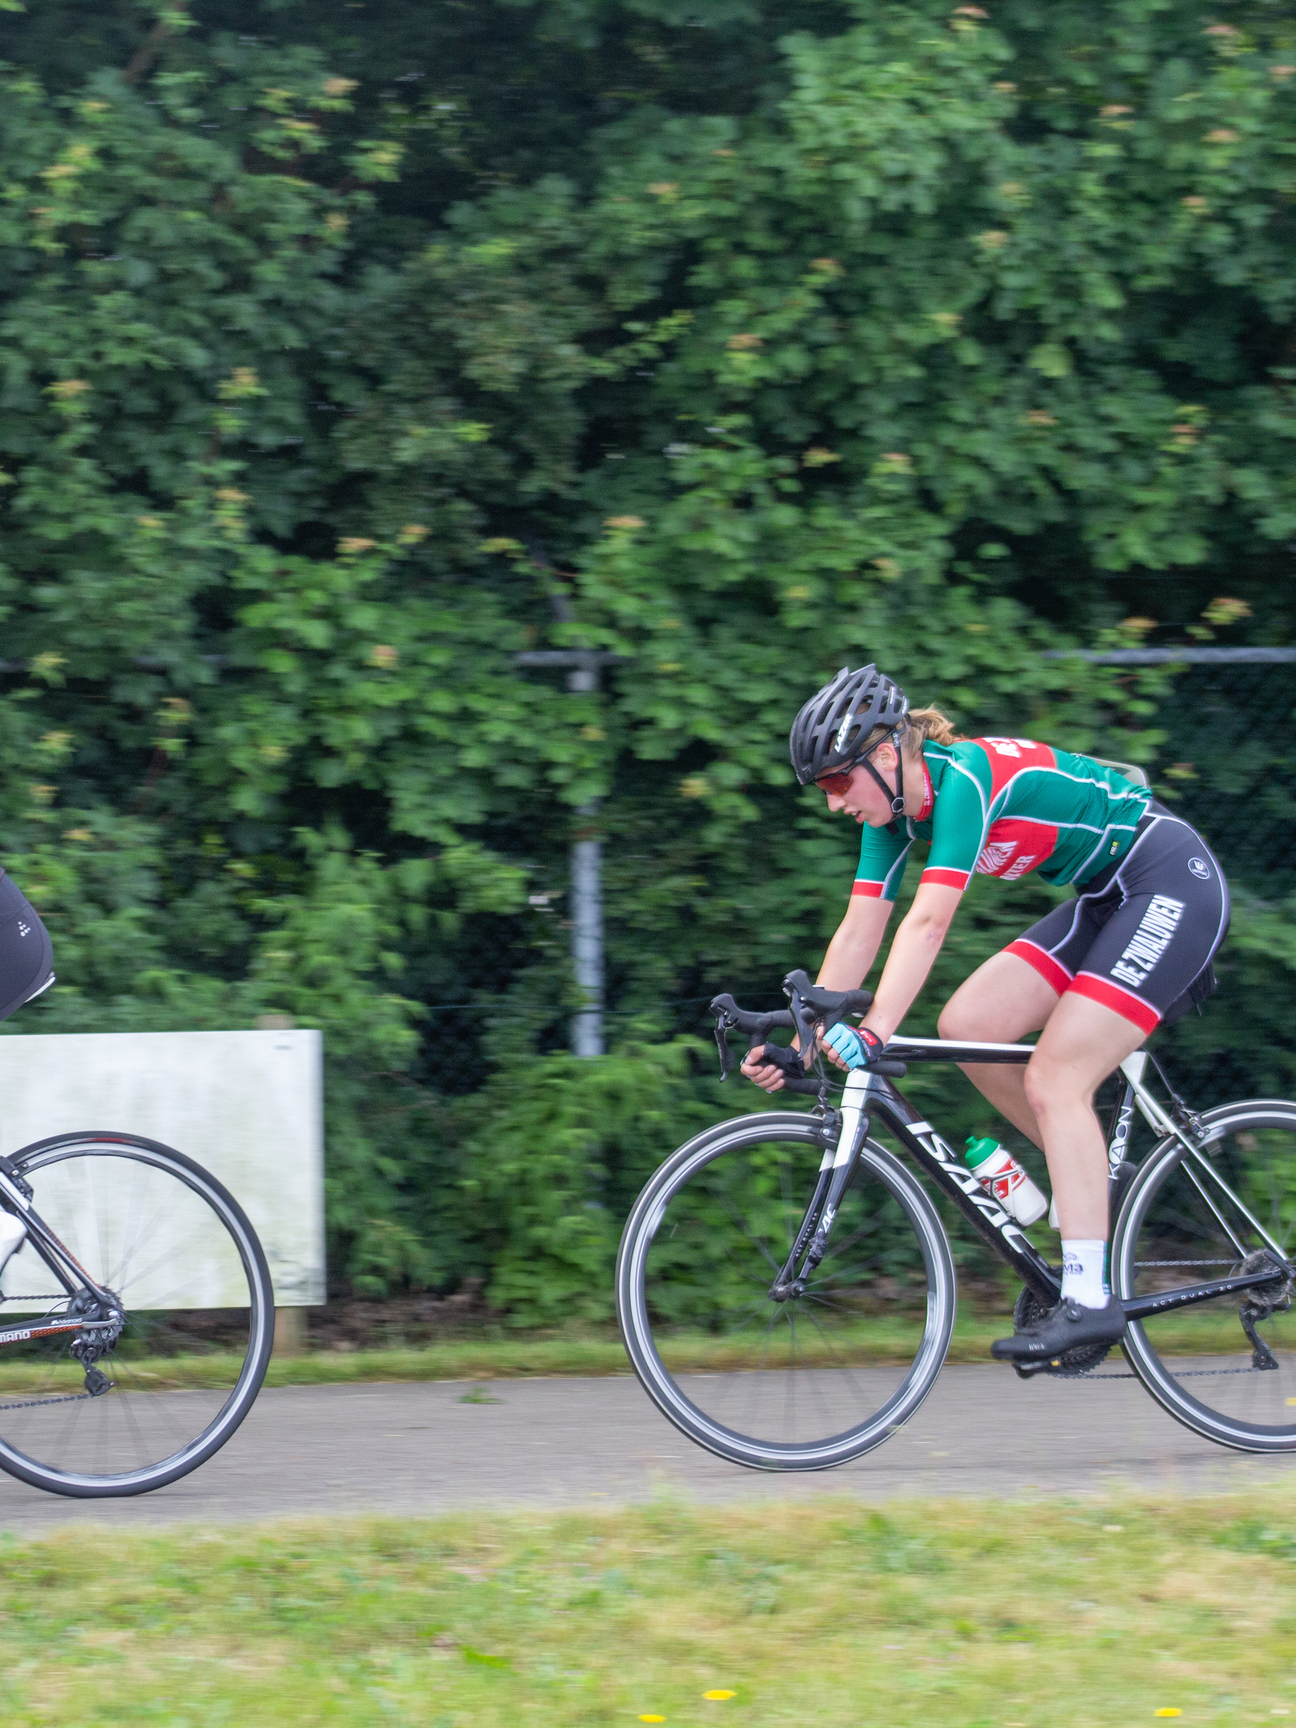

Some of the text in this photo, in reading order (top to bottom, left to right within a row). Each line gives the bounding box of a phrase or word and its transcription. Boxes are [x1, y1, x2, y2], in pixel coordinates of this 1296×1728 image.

[1109, 893, 1187, 988] DE ZWALUWEN
[905, 1121, 1036, 1254] ISAAC
[1152, 1298, 1173, 1308] ACT
[1180, 1289, 1211, 1300] DUAL
